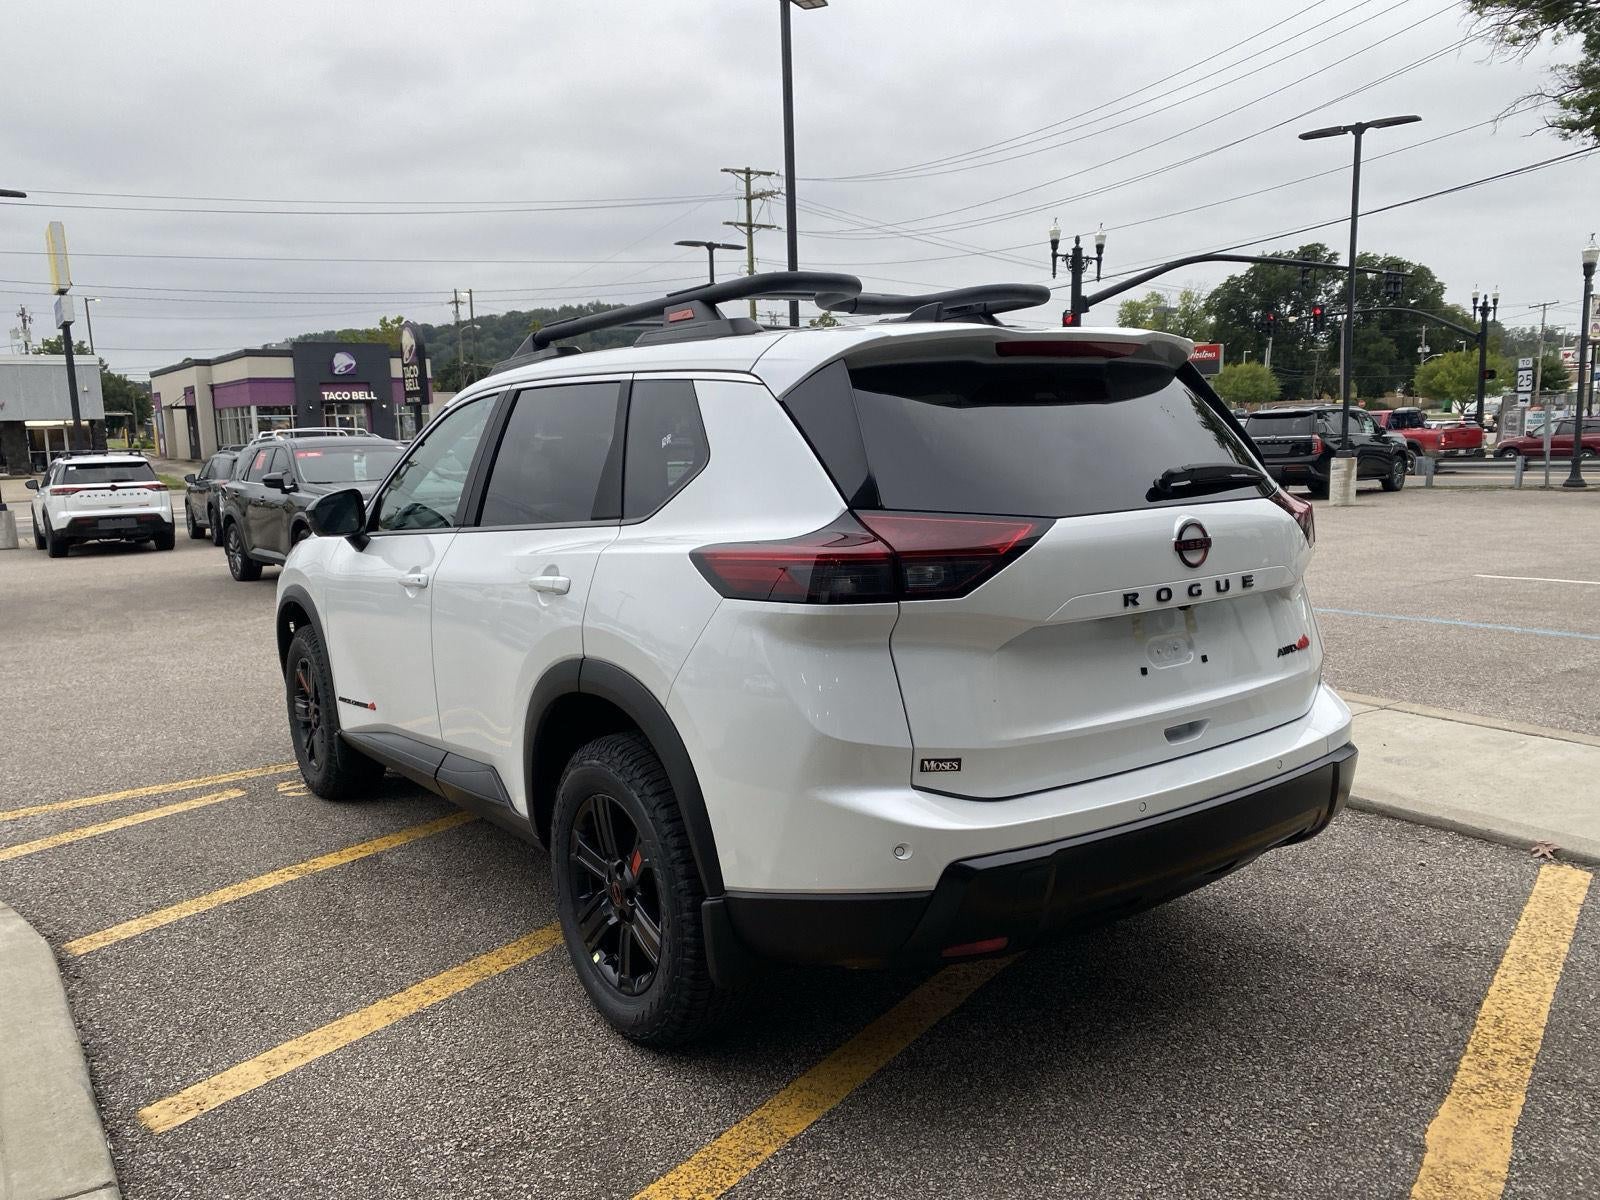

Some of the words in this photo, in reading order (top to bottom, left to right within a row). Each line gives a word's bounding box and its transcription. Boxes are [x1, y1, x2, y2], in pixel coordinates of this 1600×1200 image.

[403, 365, 419, 379] TACO
[405, 378, 420, 391] BELL
[1518, 374, 1532, 388] 25
[321, 391, 350, 400] TACO
[351, 391, 378, 400] BELL
[1122, 574, 1254, 607] ROGUE
